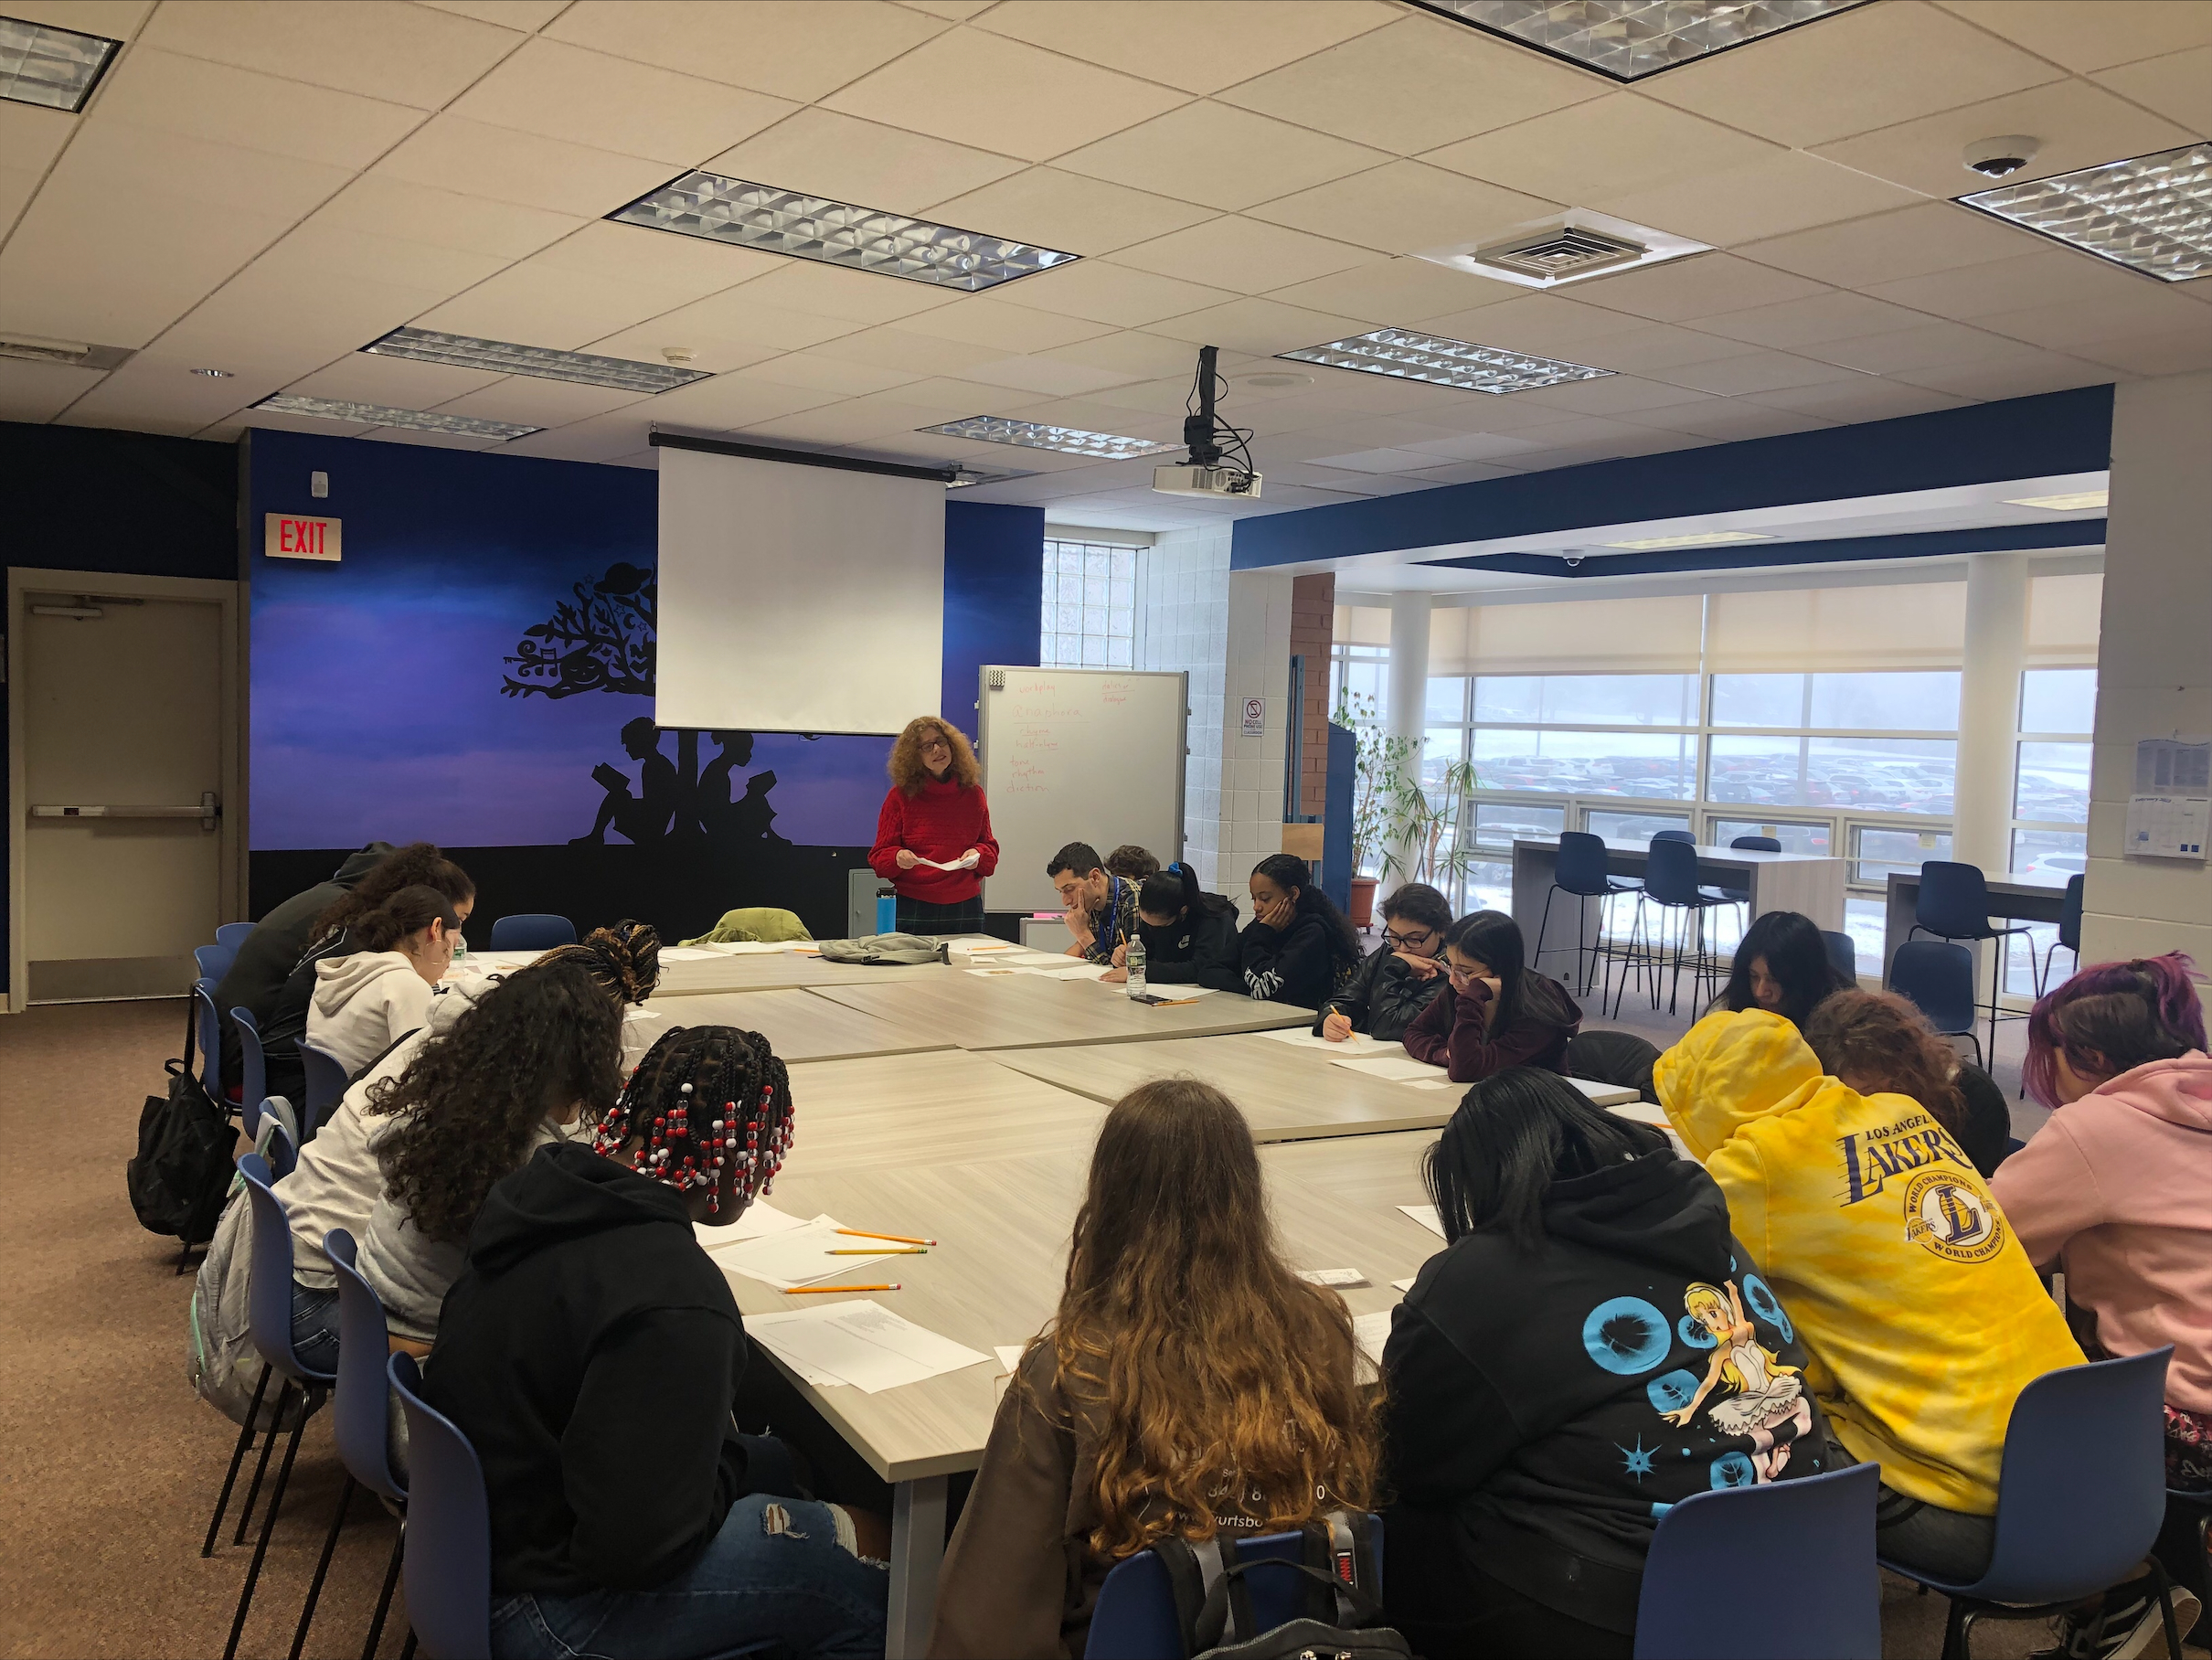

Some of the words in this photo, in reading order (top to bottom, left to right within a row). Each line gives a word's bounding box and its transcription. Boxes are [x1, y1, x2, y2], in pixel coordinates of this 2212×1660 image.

[280, 519, 327, 555] EXIT
[1010, 755, 1029, 767] tone
[1006, 780, 1050, 793] diction
[1865, 1125, 1890, 1141] LOS
[1892, 1113, 1935, 1135] ANGEL
[1835, 1125, 1973, 1208] LAKERS
[1909, 1182, 1924, 1213] WORLD
[1921, 1175, 1973, 1191] CHAMPIONS
[1907, 1220, 1938, 1241] LAKERS
[1933, 1241, 1973, 1259] WORLD
[1973, 1219, 2002, 1258] CHAMPIONS
